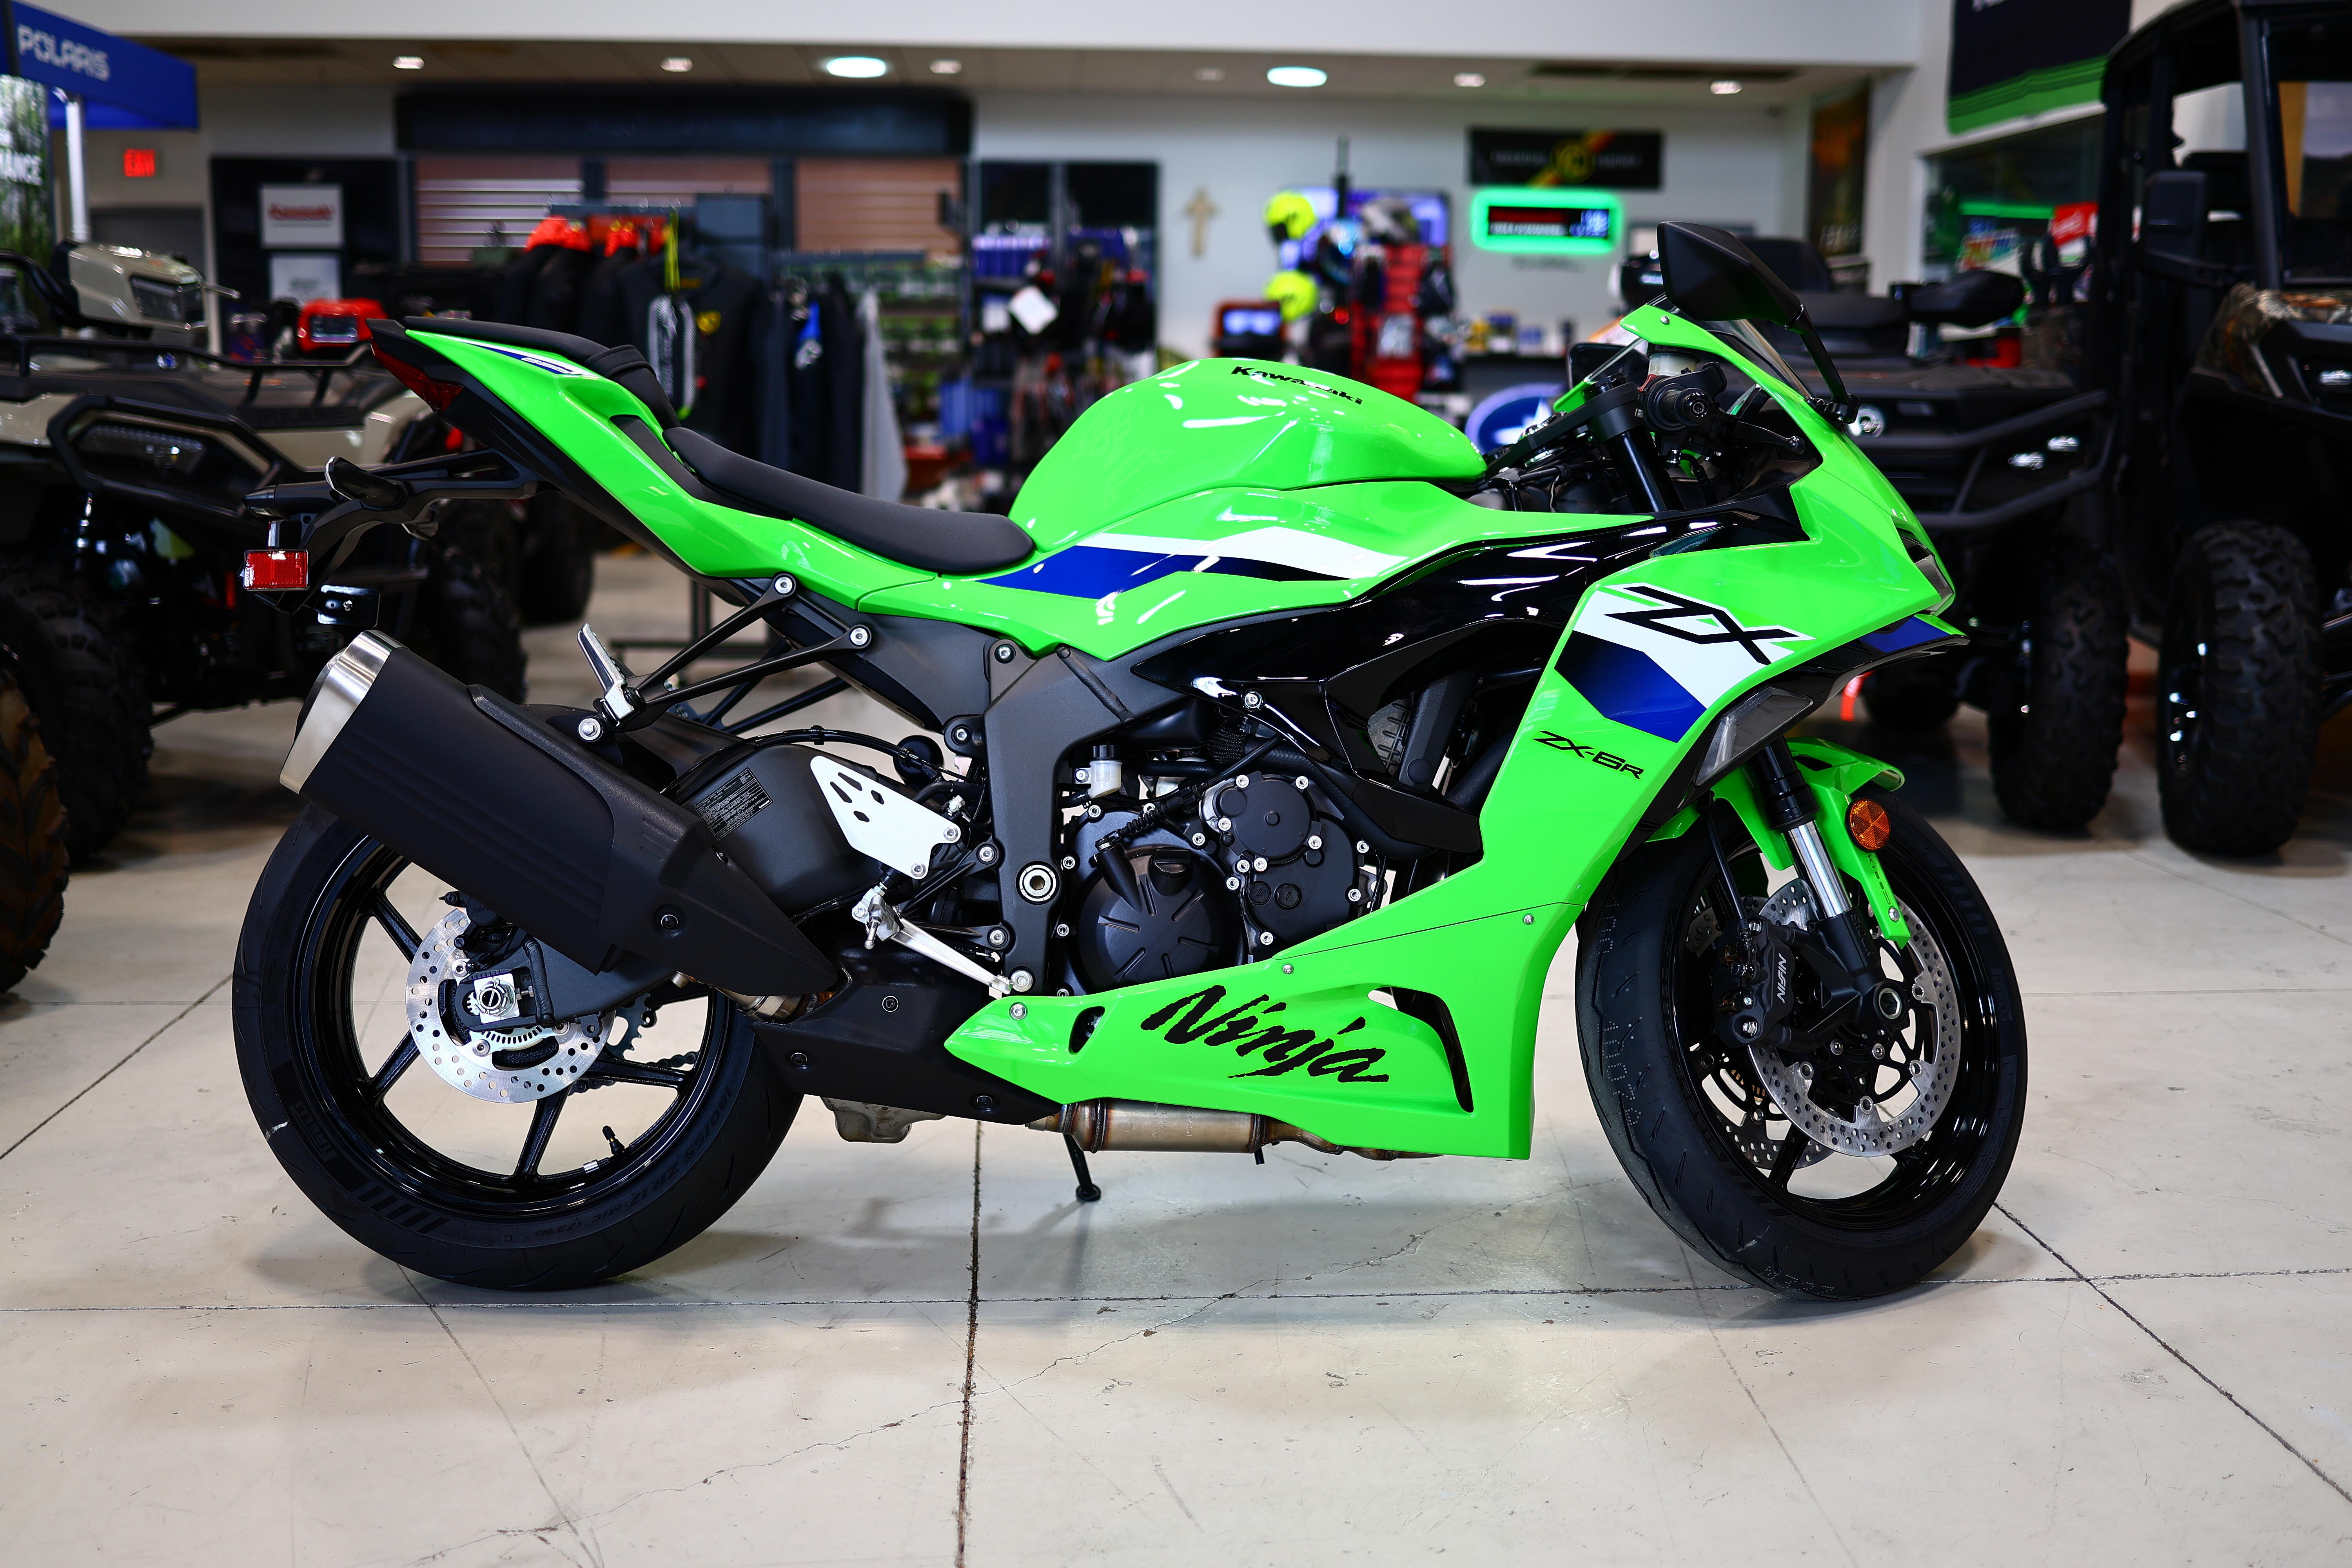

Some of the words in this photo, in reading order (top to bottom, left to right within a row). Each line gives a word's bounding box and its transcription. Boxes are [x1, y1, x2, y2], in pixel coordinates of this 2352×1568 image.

[18, 24, 110, 82] POLARIS
[1603, 586, 1800, 665] ZX
[1532, 730, 1644, 779] ZX-6R
[1777, 953, 1788, 1004] NISSIN
[1140, 984, 1389, 1083] Ninja
